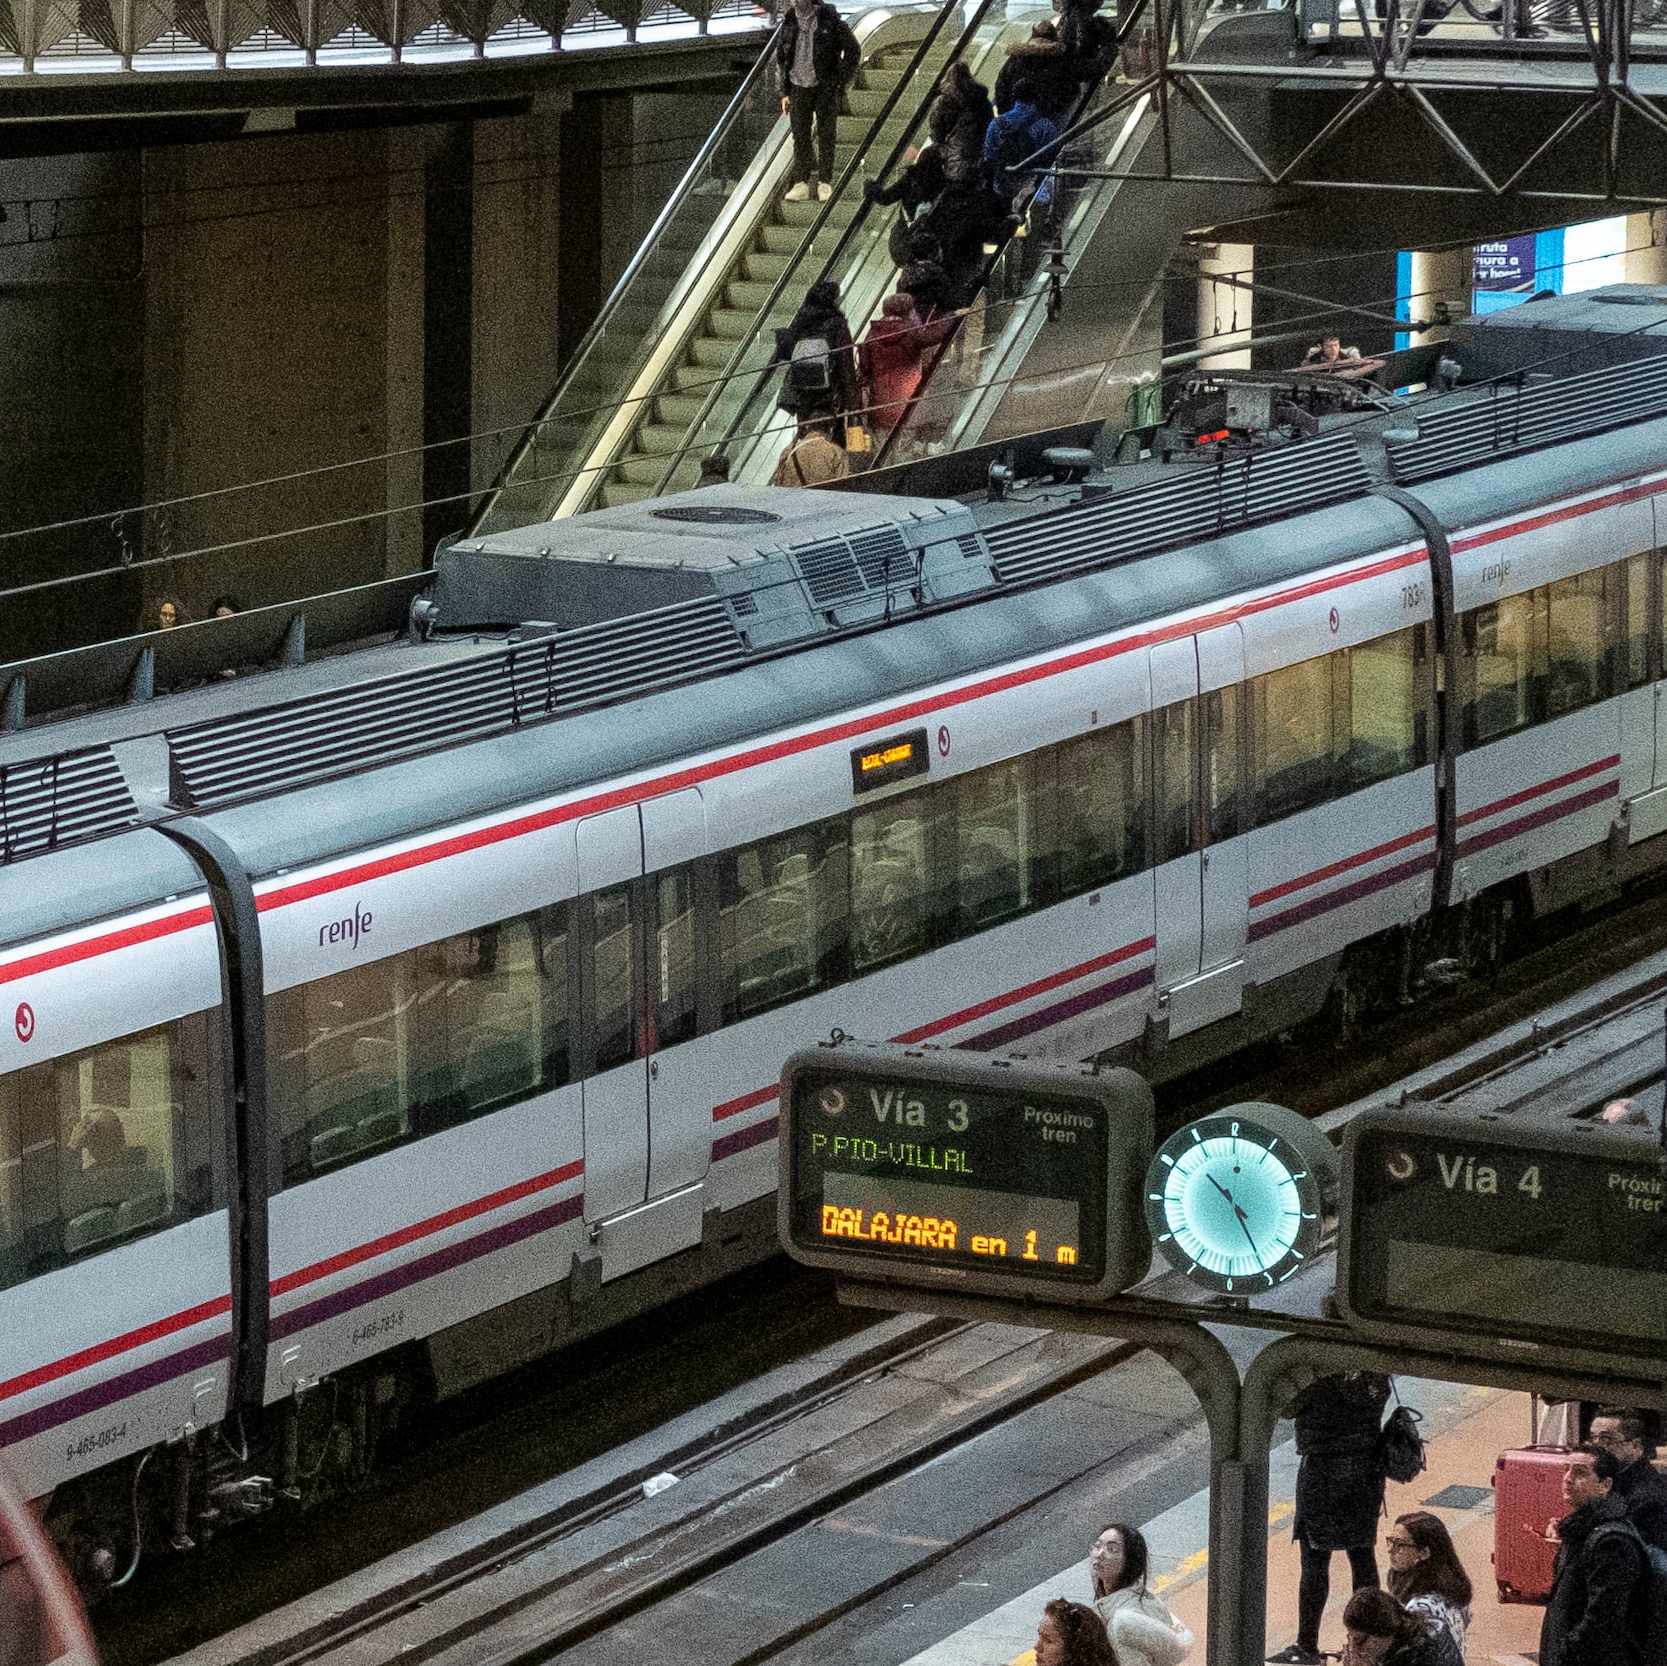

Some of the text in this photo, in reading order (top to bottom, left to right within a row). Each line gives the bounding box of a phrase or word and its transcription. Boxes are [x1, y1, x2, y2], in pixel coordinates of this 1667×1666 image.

[1480, 553, 1513, 586] renfe
[318, 899, 374, 952] renfe
[869, 1088, 970, 1133] Vía 3
[1023, 1104, 1095, 1131] Próximo
[811, 1132, 974, 1174] P.PIO-VILLAL
[1041, 1125, 1077, 1144] tren
[1436, 1153, 1543, 1199] Vía 4
[970, 1235, 1008, 1258] en
